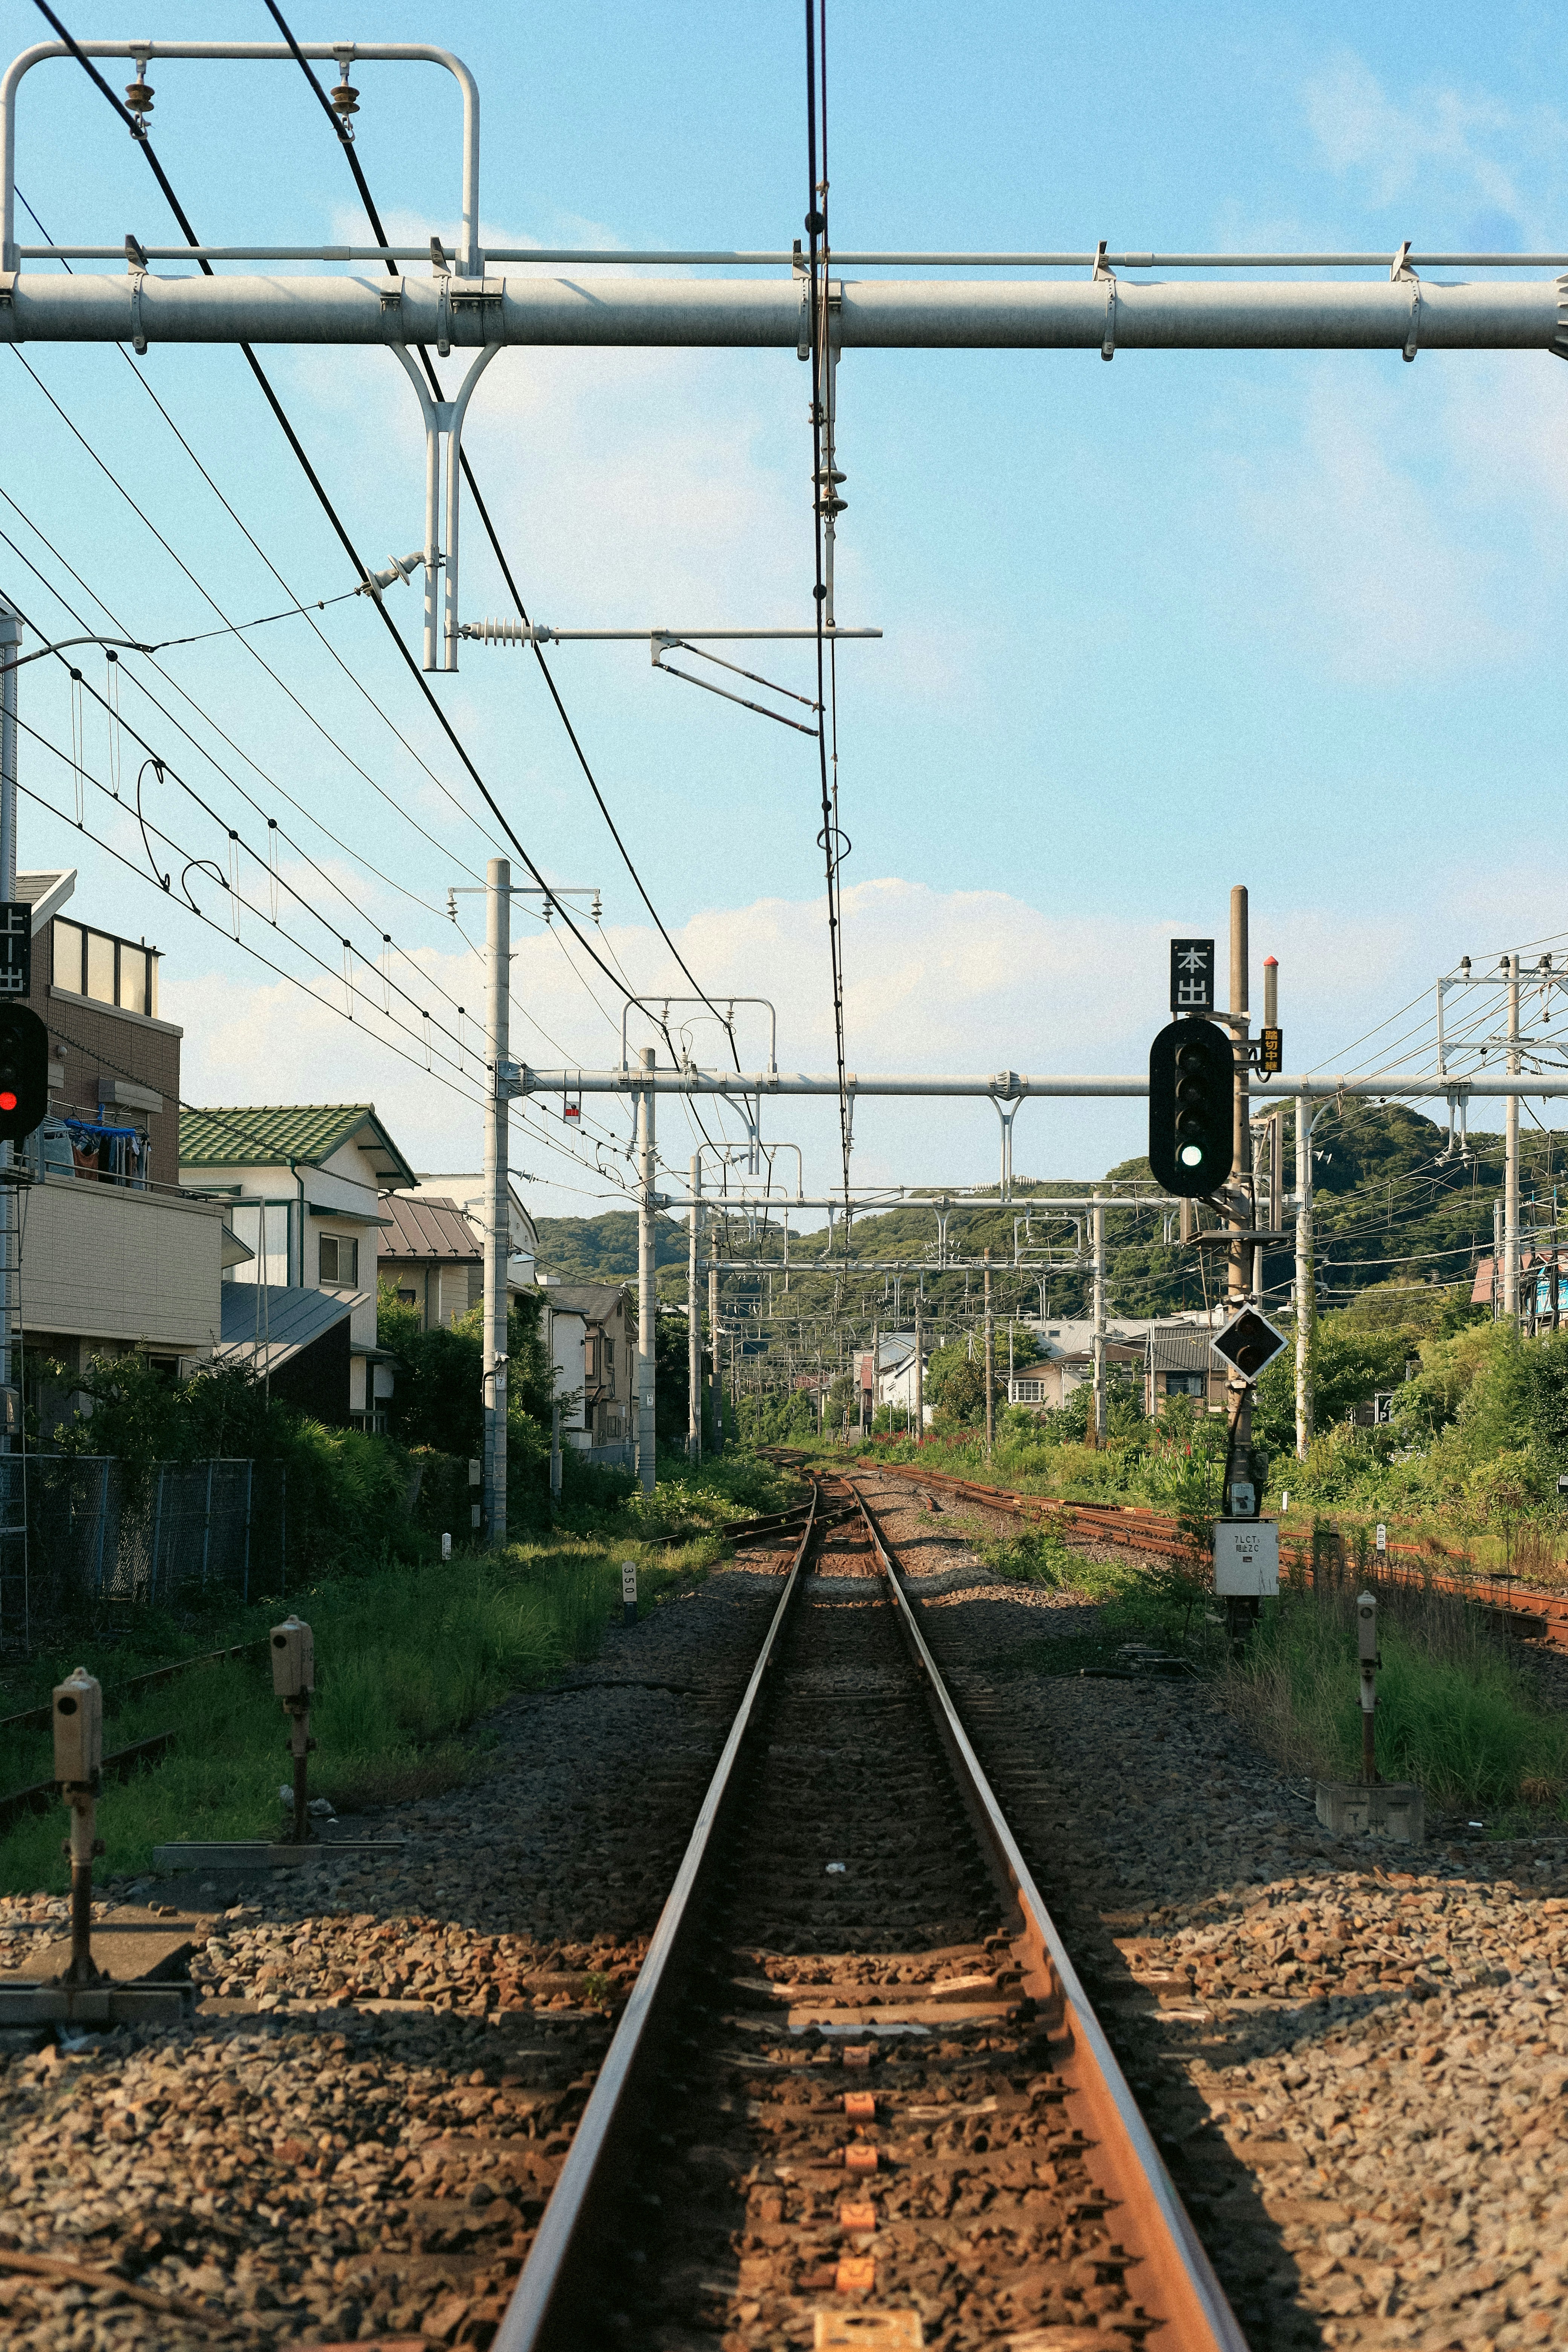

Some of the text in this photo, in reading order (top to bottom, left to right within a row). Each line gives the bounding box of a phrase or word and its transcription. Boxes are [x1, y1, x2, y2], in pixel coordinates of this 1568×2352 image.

[1178, 947, 1207, 1004] 本出
[1265, 1031, 1278, 1070] 踏切中継
[624, 1568, 635, 1593] 350
